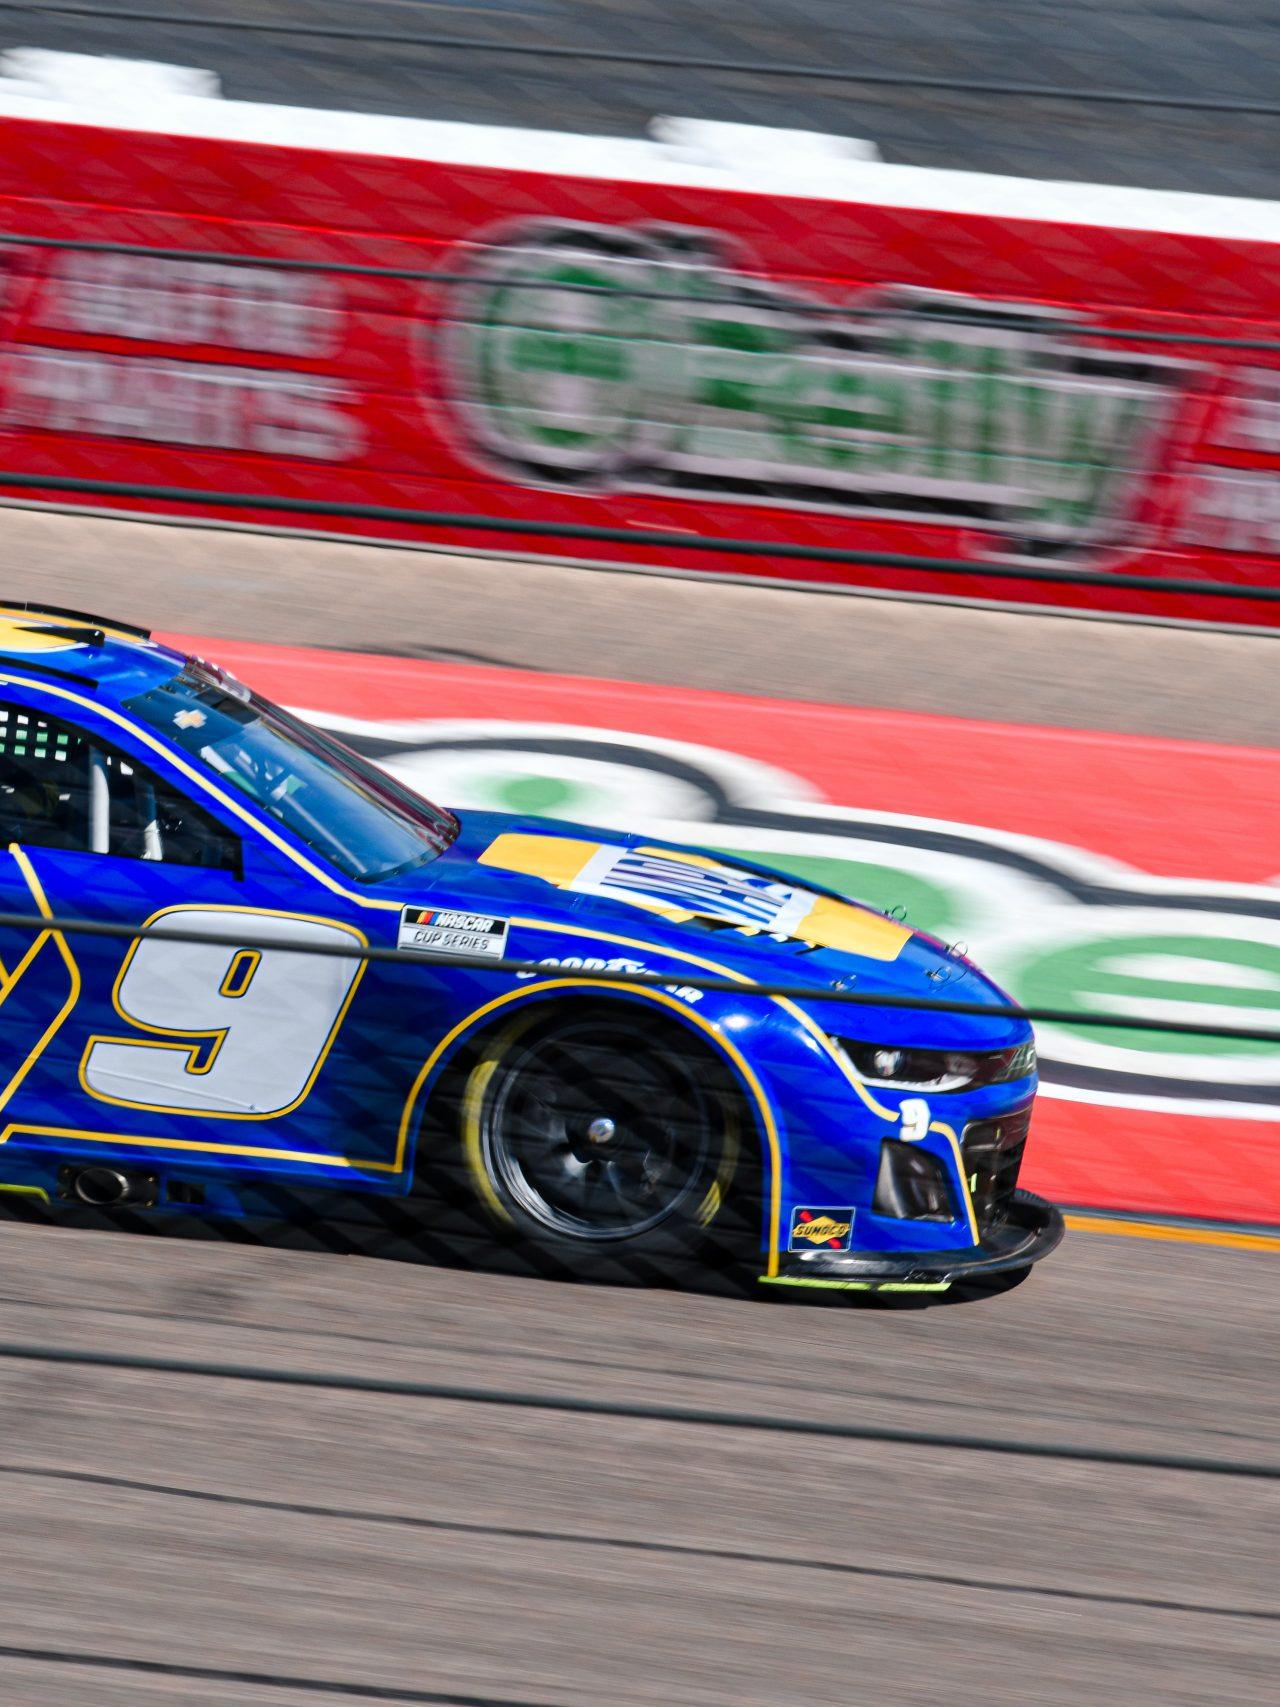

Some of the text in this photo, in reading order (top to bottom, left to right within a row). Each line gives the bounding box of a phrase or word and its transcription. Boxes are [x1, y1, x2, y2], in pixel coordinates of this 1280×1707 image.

[434, 911, 495, 933] NASCAR
[414, 931, 490, 950] CUP SERIES
[78, 904, 370, 1121] 9
[899, 1098, 931, 1142] 9
[795, 1223, 847, 1237] SUNOCO
